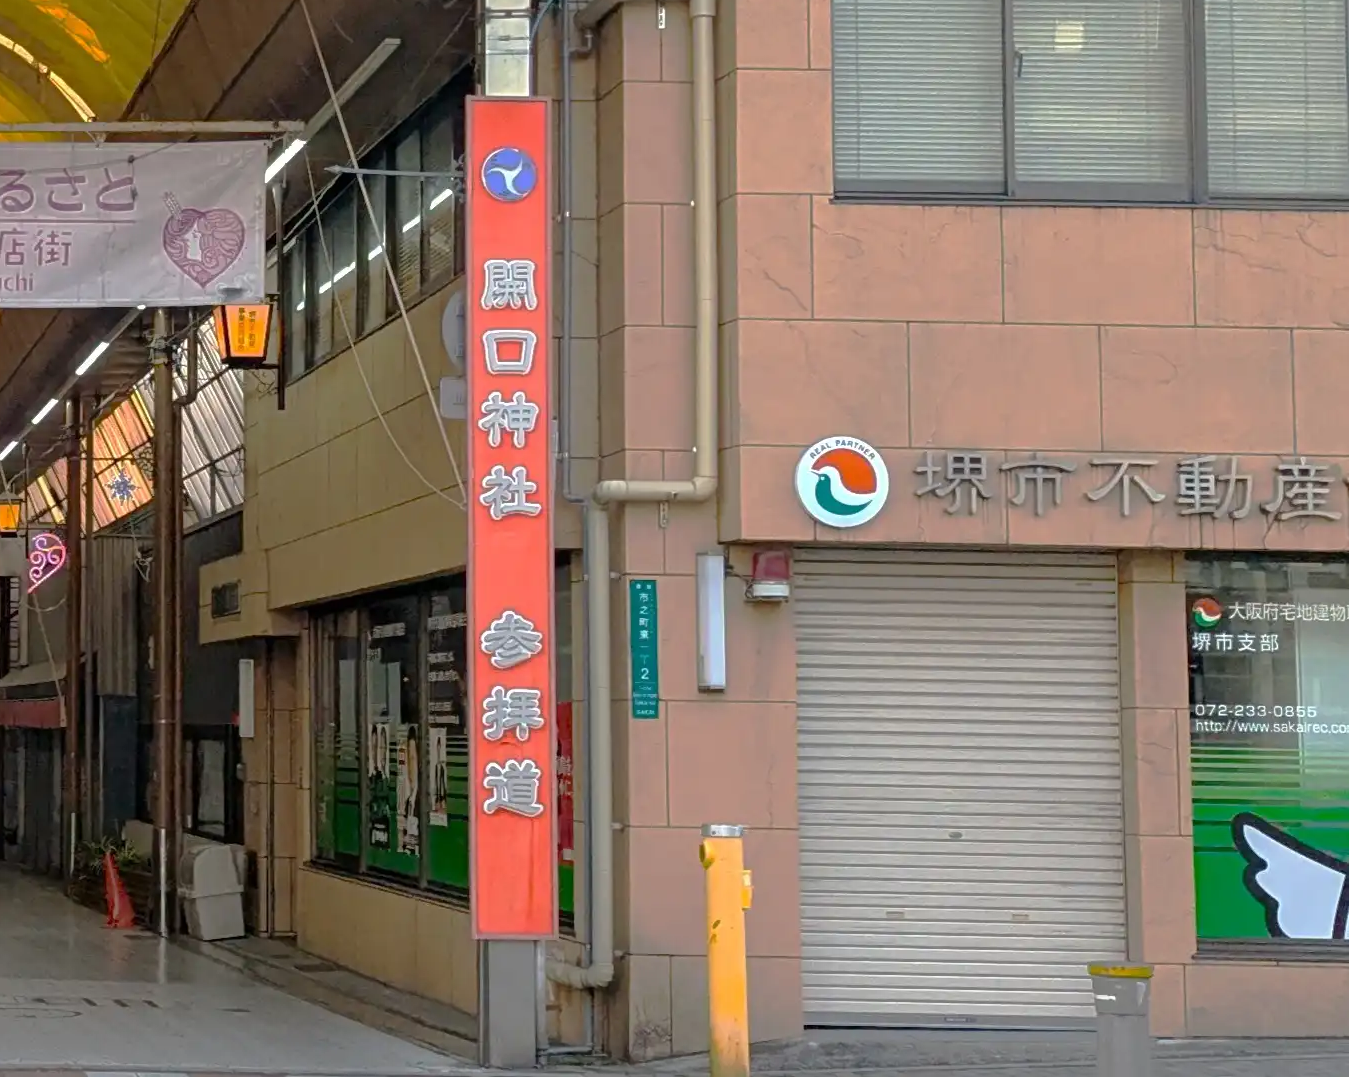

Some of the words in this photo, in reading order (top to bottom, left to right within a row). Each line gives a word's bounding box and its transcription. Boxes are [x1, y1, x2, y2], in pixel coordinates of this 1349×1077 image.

[477, 258, 542, 520] 開口神社
[809, 442, 832, 460] REAL
[834, 439, 877, 461] PARTNER
[1228, 601, 1349, 622] 大阪府宅地建物
[1192, 631, 1280, 653] 堺市支部
[640, 667, 650, 680] 2
[480, 610, 544, 818] 参拝道
[1194, 704, 1318, 718] 072-233-0855
[1194, 720, 1349, 734] http://www.sakairec.co
